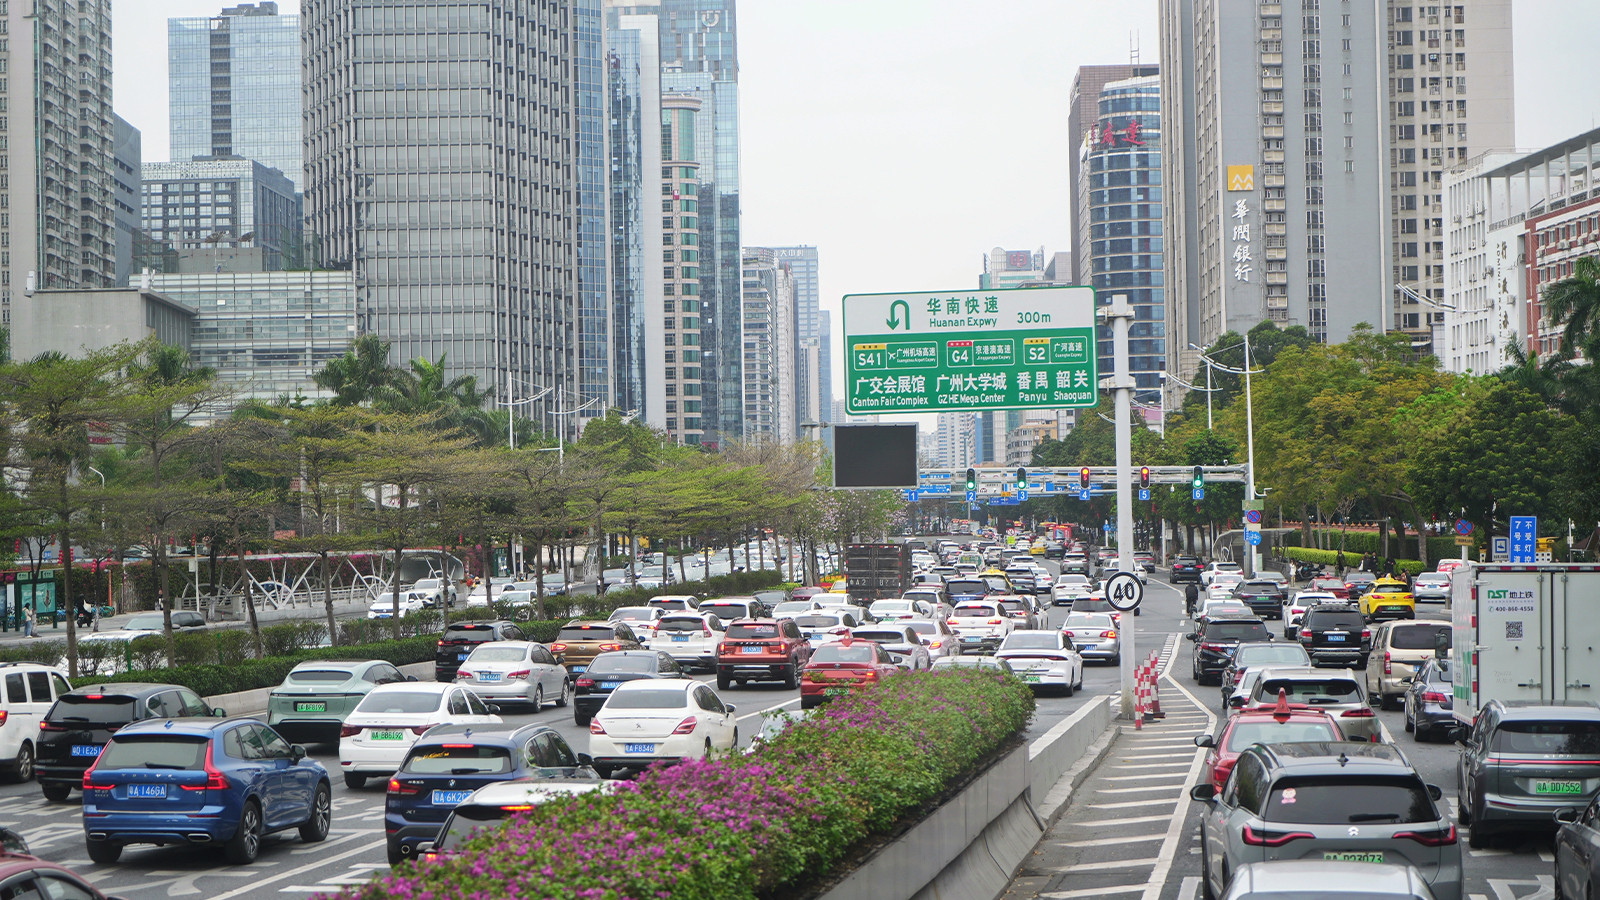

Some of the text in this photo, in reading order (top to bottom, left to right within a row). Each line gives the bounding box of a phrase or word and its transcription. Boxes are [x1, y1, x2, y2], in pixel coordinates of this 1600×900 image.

[927, 296, 999, 315] 华南快速
[929, 317, 997, 328] Huanan Expwy
[1017, 312, 1051, 323] 300m
[896, 347, 936, 357] 广州机场高速
[975, 344, 1011, 354] 京港澳高速
[1054, 342, 1082, 352] 广河高速
[858, 352, 881, 366] S41
[951, 349, 968, 363] G4
[1029, 347, 1046, 360] S2
[936, 372, 1008, 392] 广州大学城
[1016, 371, 1048, 390] 番禺
[1056, 370, 1089, 388] 韶关
[855, 375, 926, 395] 广交会展馆
[852, 395, 929, 407] Canton Fair Complex
[938, 393, 1006, 406] GZ HE Mega Center
[1018, 392, 1047, 403] Panyu
[1054, 391, 1092, 403] Shaoguan
[969, 492, 974, 500] 2
[1020, 491, 1025, 499] 3
[1082, 491, 1087, 499] 4
[1142, 490, 1147, 499] 5
[1195, 490, 1201, 498] 6
[1113, 583, 1135, 600] 40
[1509, 591, 1533, 599] 地上铁
